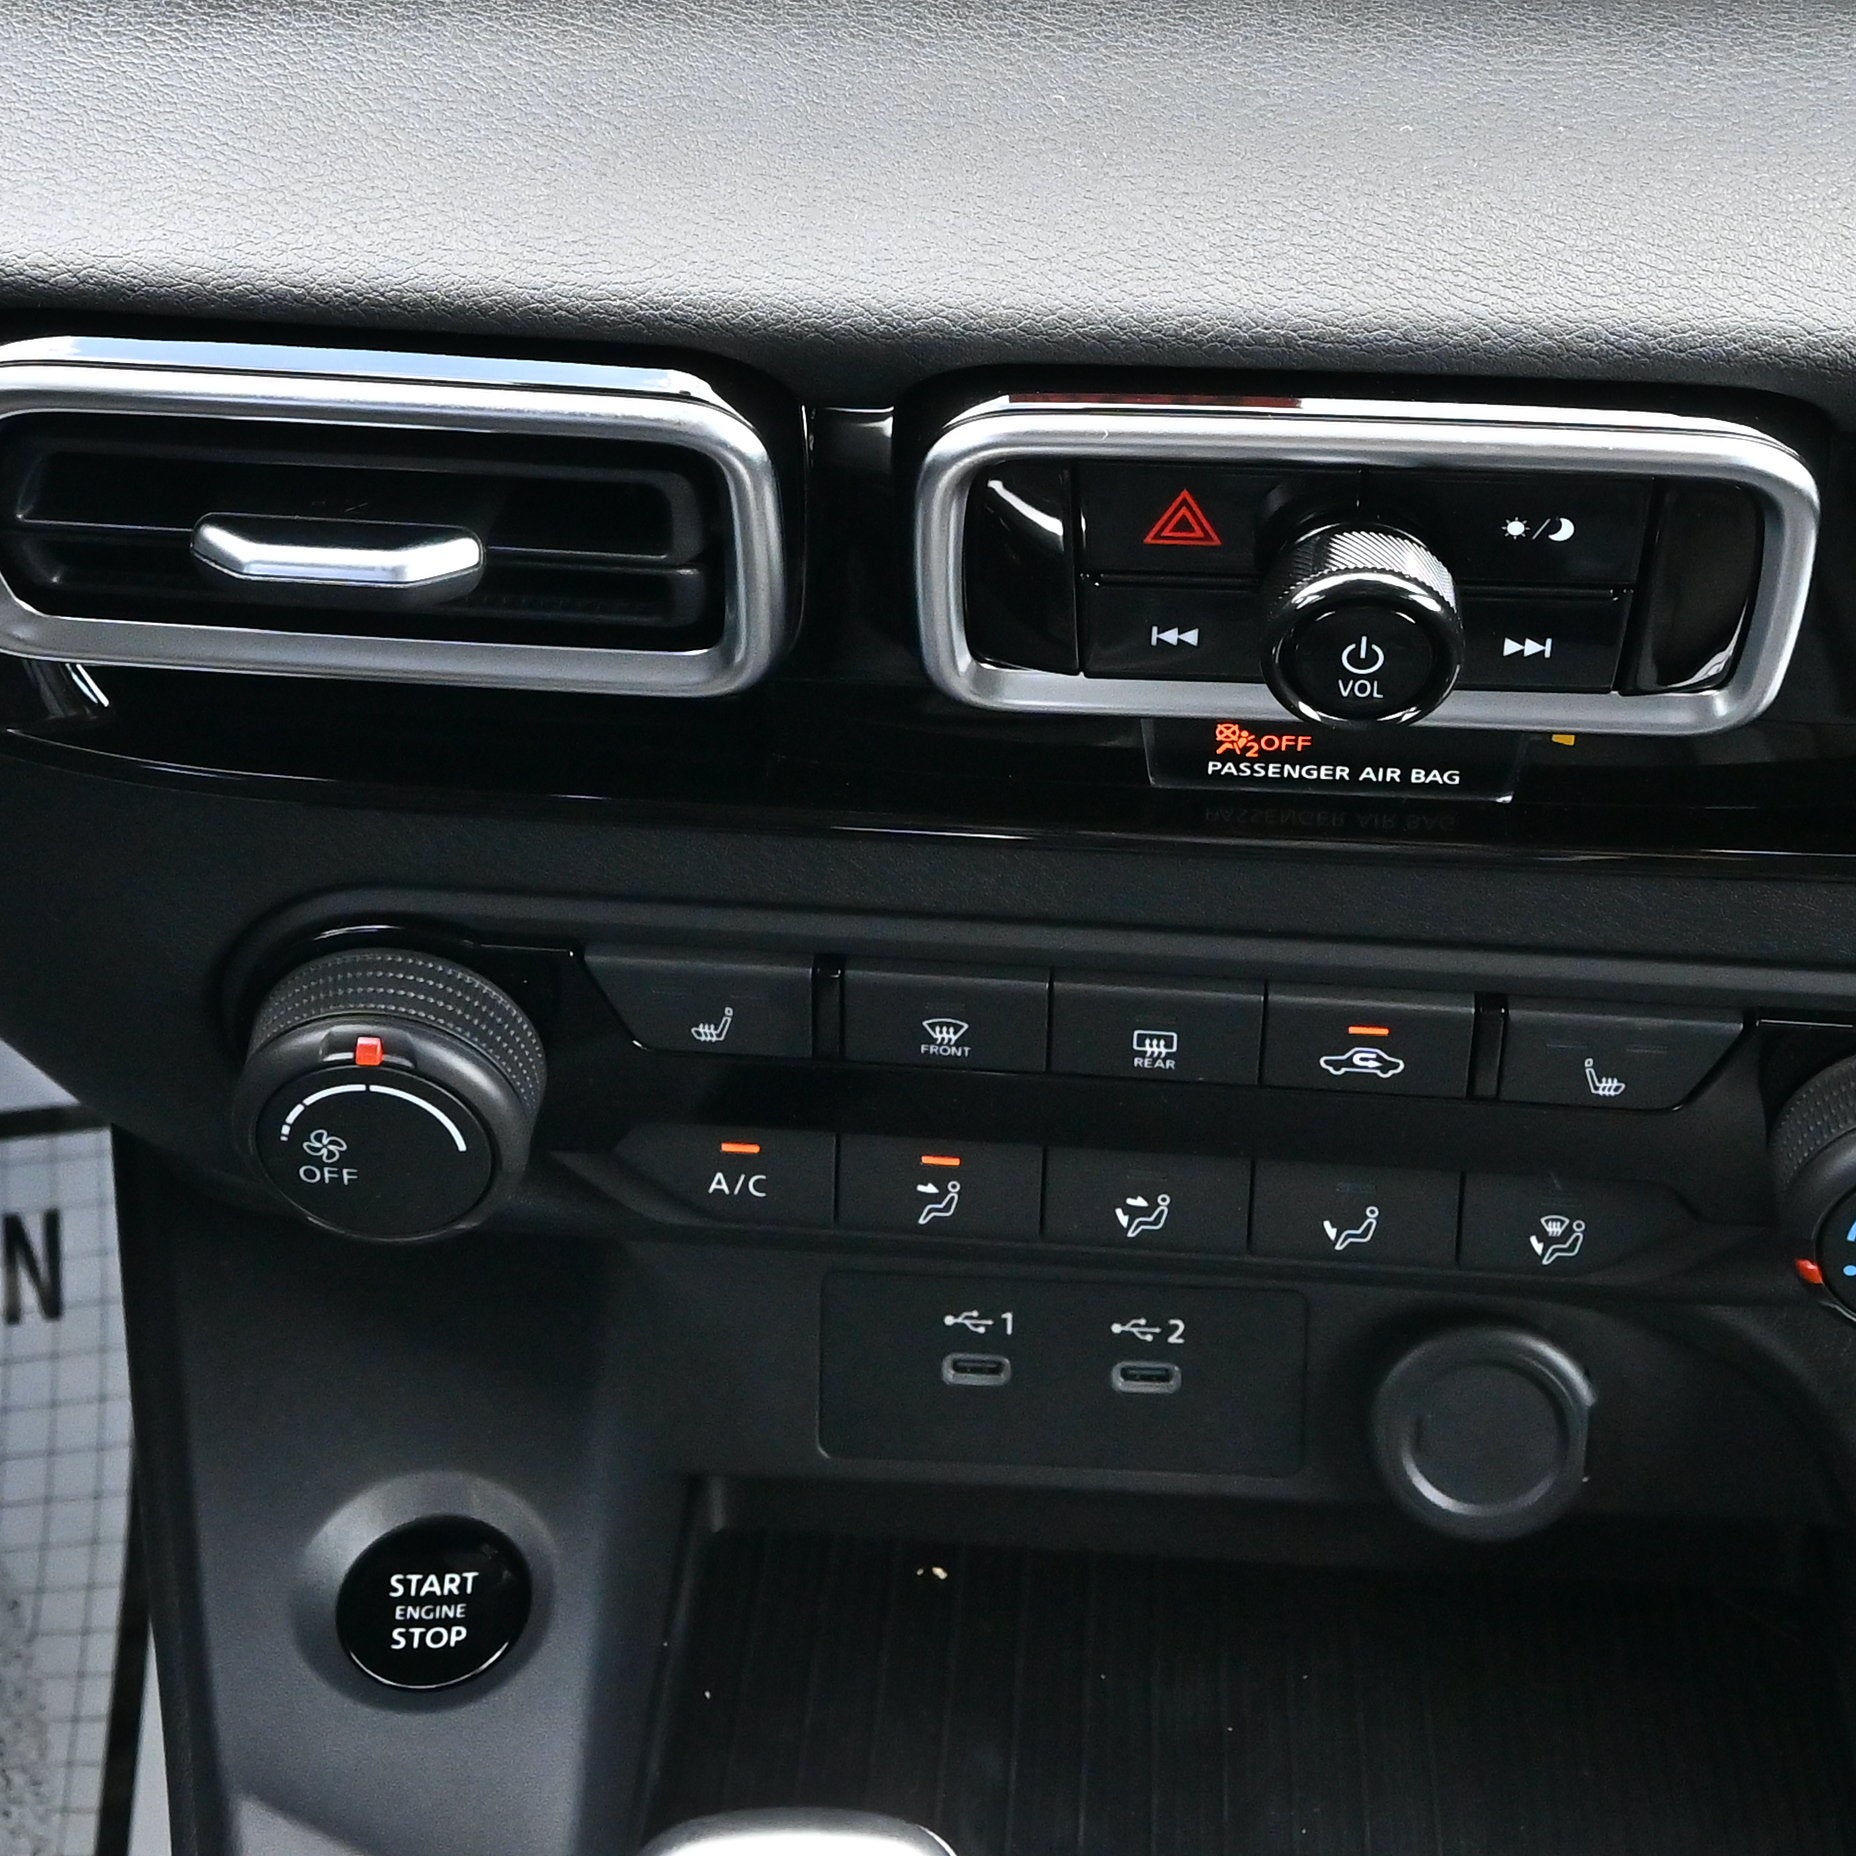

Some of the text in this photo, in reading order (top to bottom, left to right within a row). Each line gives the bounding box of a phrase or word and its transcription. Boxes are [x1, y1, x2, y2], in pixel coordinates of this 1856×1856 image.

[1338, 679, 1383, 698] VOL
[1260, 735, 1312, 751] OFF
[1208, 761, 1460, 785] PASSENGER AIR BAG
[920, 1044, 971, 1056] FRONT
[1134, 1057, 1176, 1070] REAR
[298, 1165, 359, 1185] OFF
[708, 1173, 767, 1197] A/C
[1001, 1312, 1013, 1335] 1
[1167, 1319, 1185, 1343] 2
[389, 1572, 479, 1597] START
[395, 1603, 466, 1620] ENGINE
[391, 1626, 467, 1649] STOP
